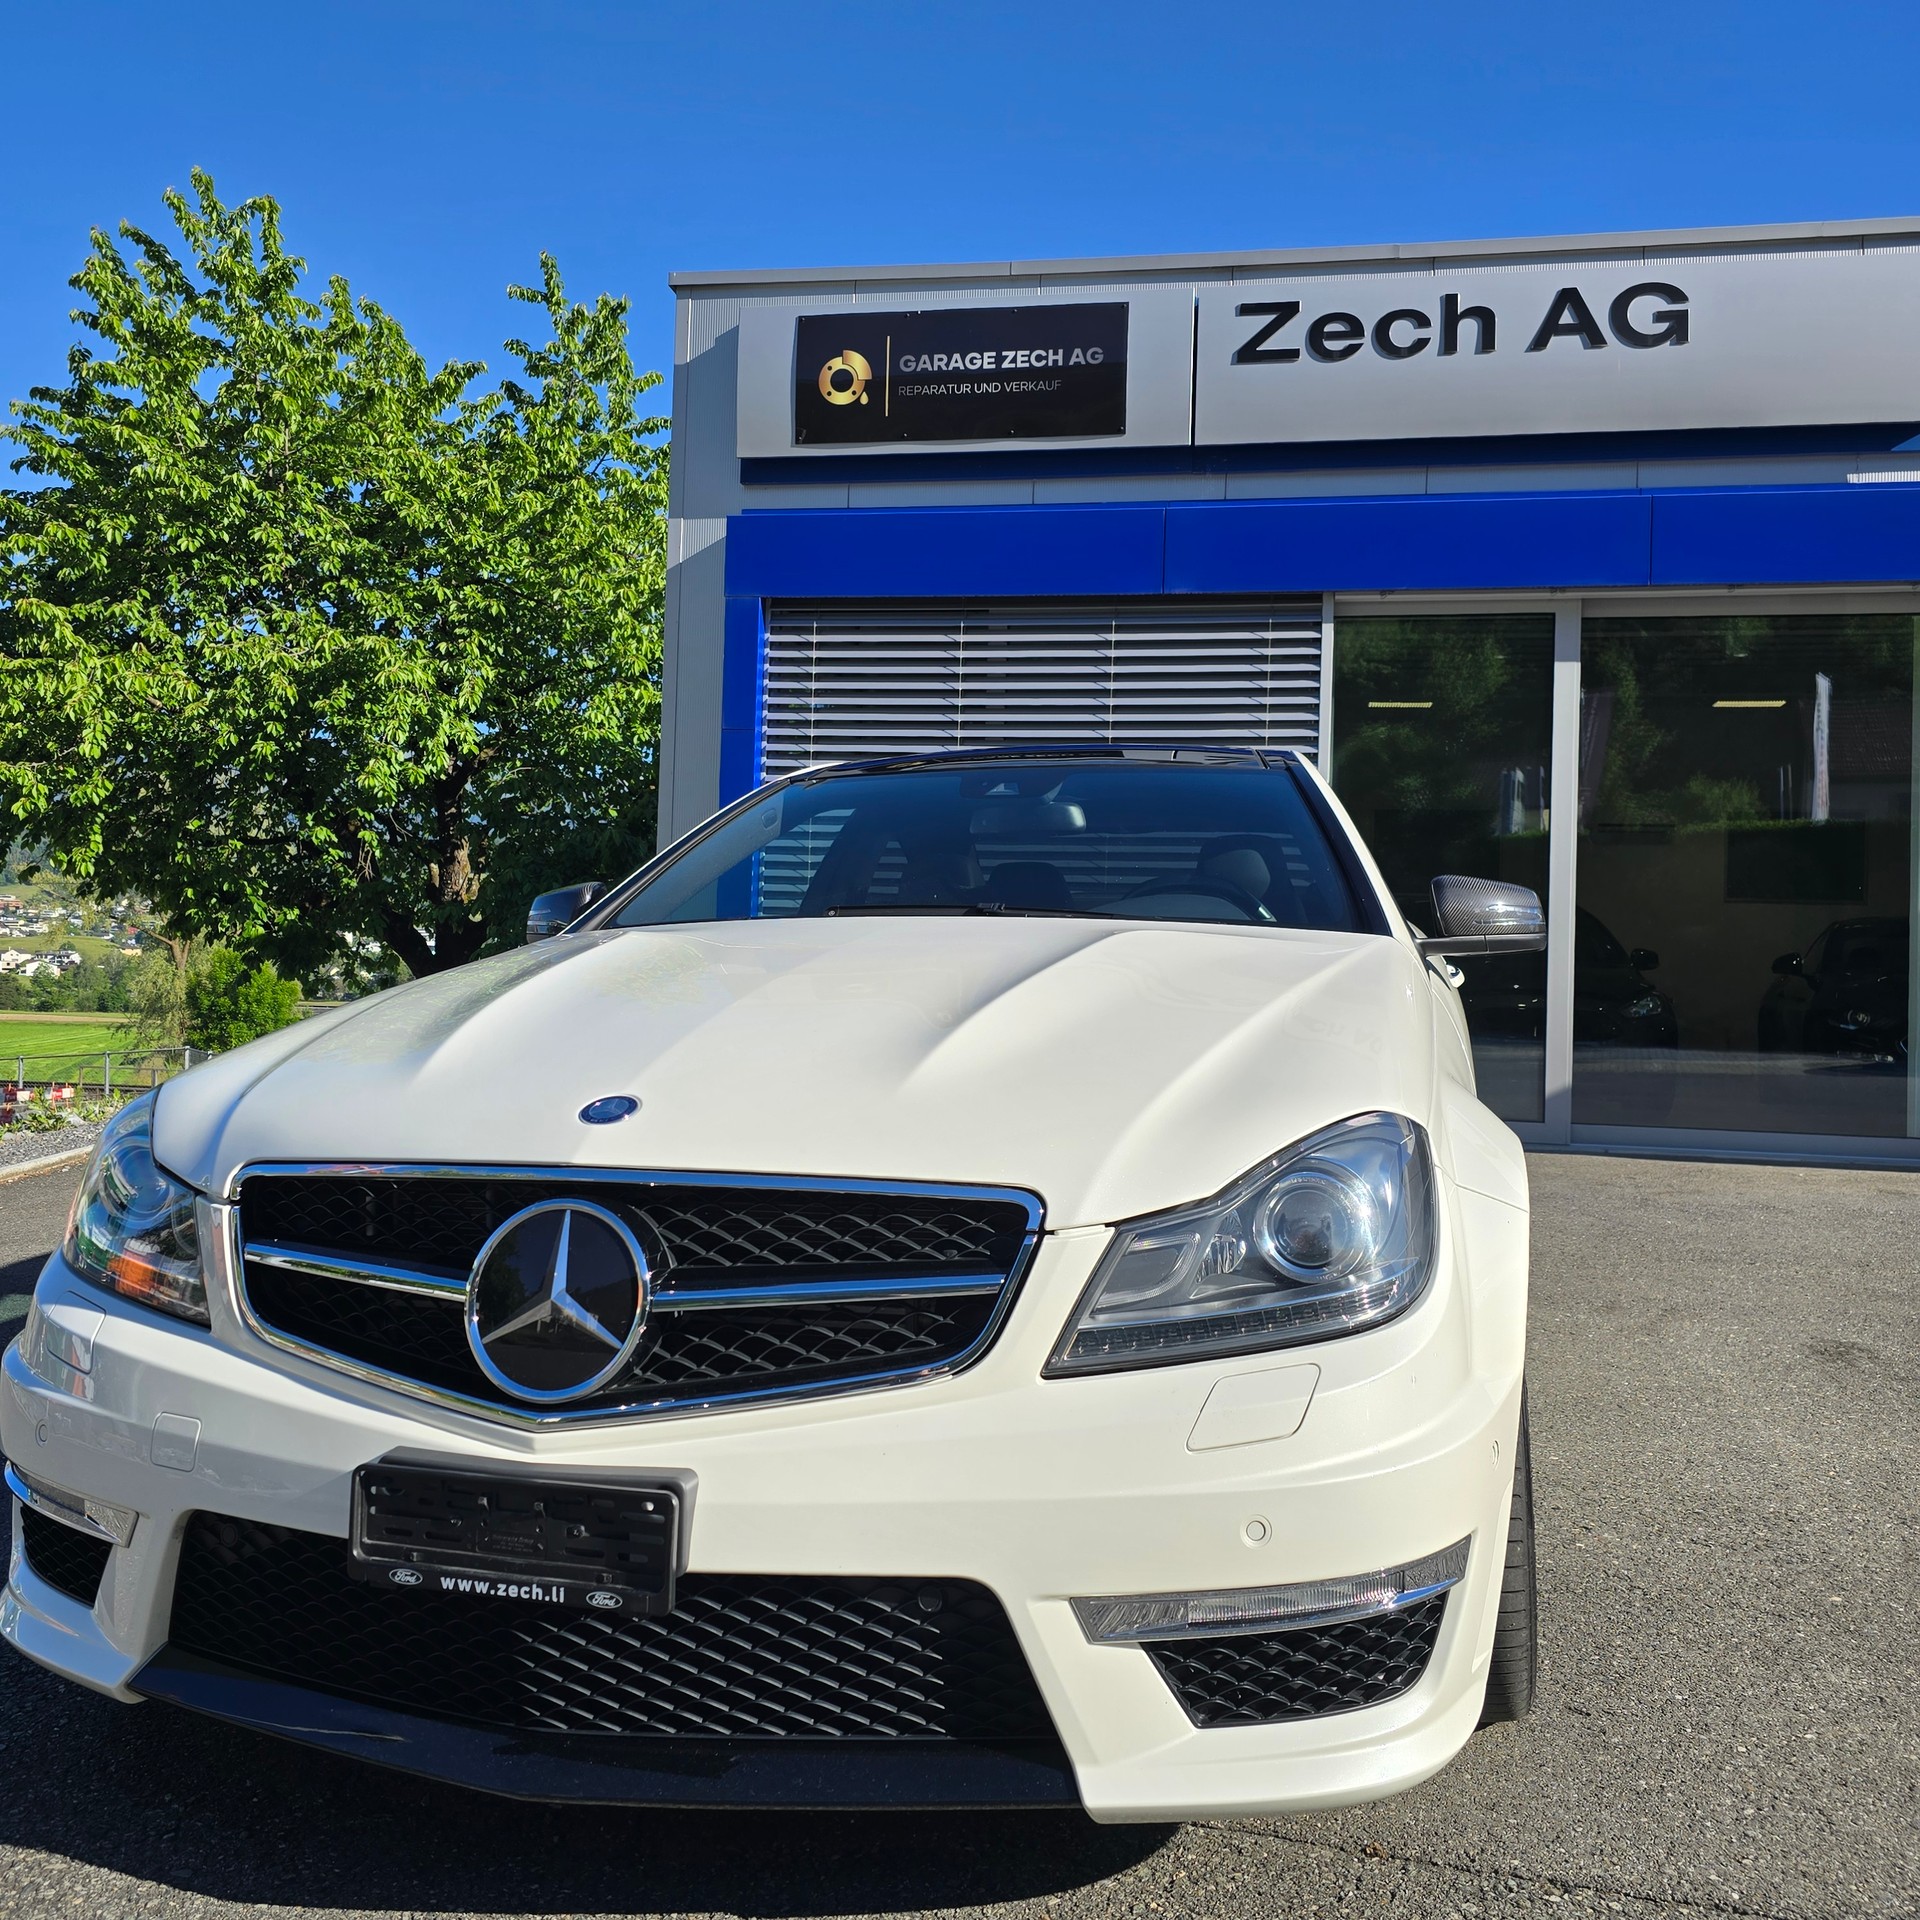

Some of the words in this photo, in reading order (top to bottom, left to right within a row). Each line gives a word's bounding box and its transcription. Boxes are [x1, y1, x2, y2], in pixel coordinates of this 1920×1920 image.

[1231, 292, 1498, 365] Zech
[1524, 281, 1691, 353] AG
[899, 352, 996, 372] GARAGE
[1001, 348, 1063, 369] ZECH
[1069, 347, 1104, 366] AG
[898, 383, 972, 397] REPARATUR
[974, 381, 1001, 394] UND
[1003, 379, 1062, 392] VERKAUF
[394, 1570, 418, 1583] Ford
[440, 1576, 565, 1603] www.zech.li
[592, 1593, 617, 1606] Ford
